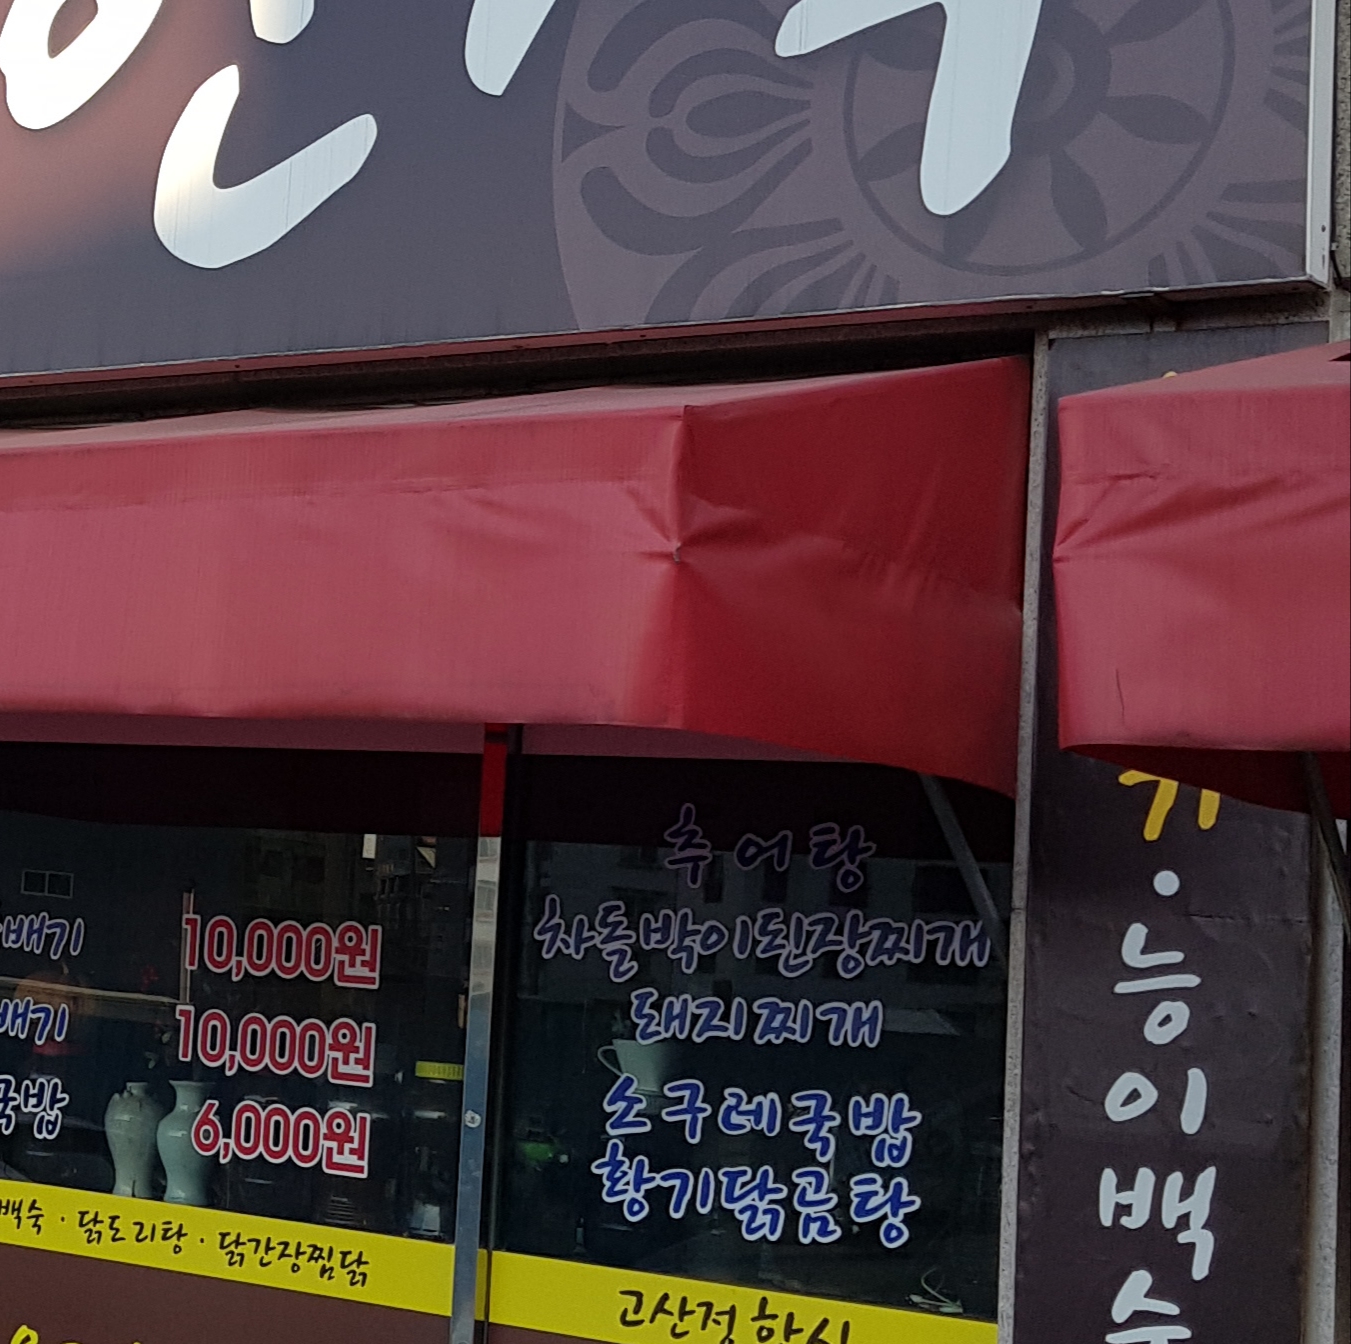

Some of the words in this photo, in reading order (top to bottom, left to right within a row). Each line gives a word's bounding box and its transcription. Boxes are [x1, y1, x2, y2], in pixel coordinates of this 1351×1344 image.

[180, 914, 382, 990] 10,000원
[175, 1003, 376, 1088] 10,000원
[191, 1100, 372, 1179] 6,000원
[592, 1140, 921, 1248] 황기닭곰탕
[77, 1210, 188, 1255] 닭도리탕
[218, 1231, 370, 1288] 닭간장찜닭
